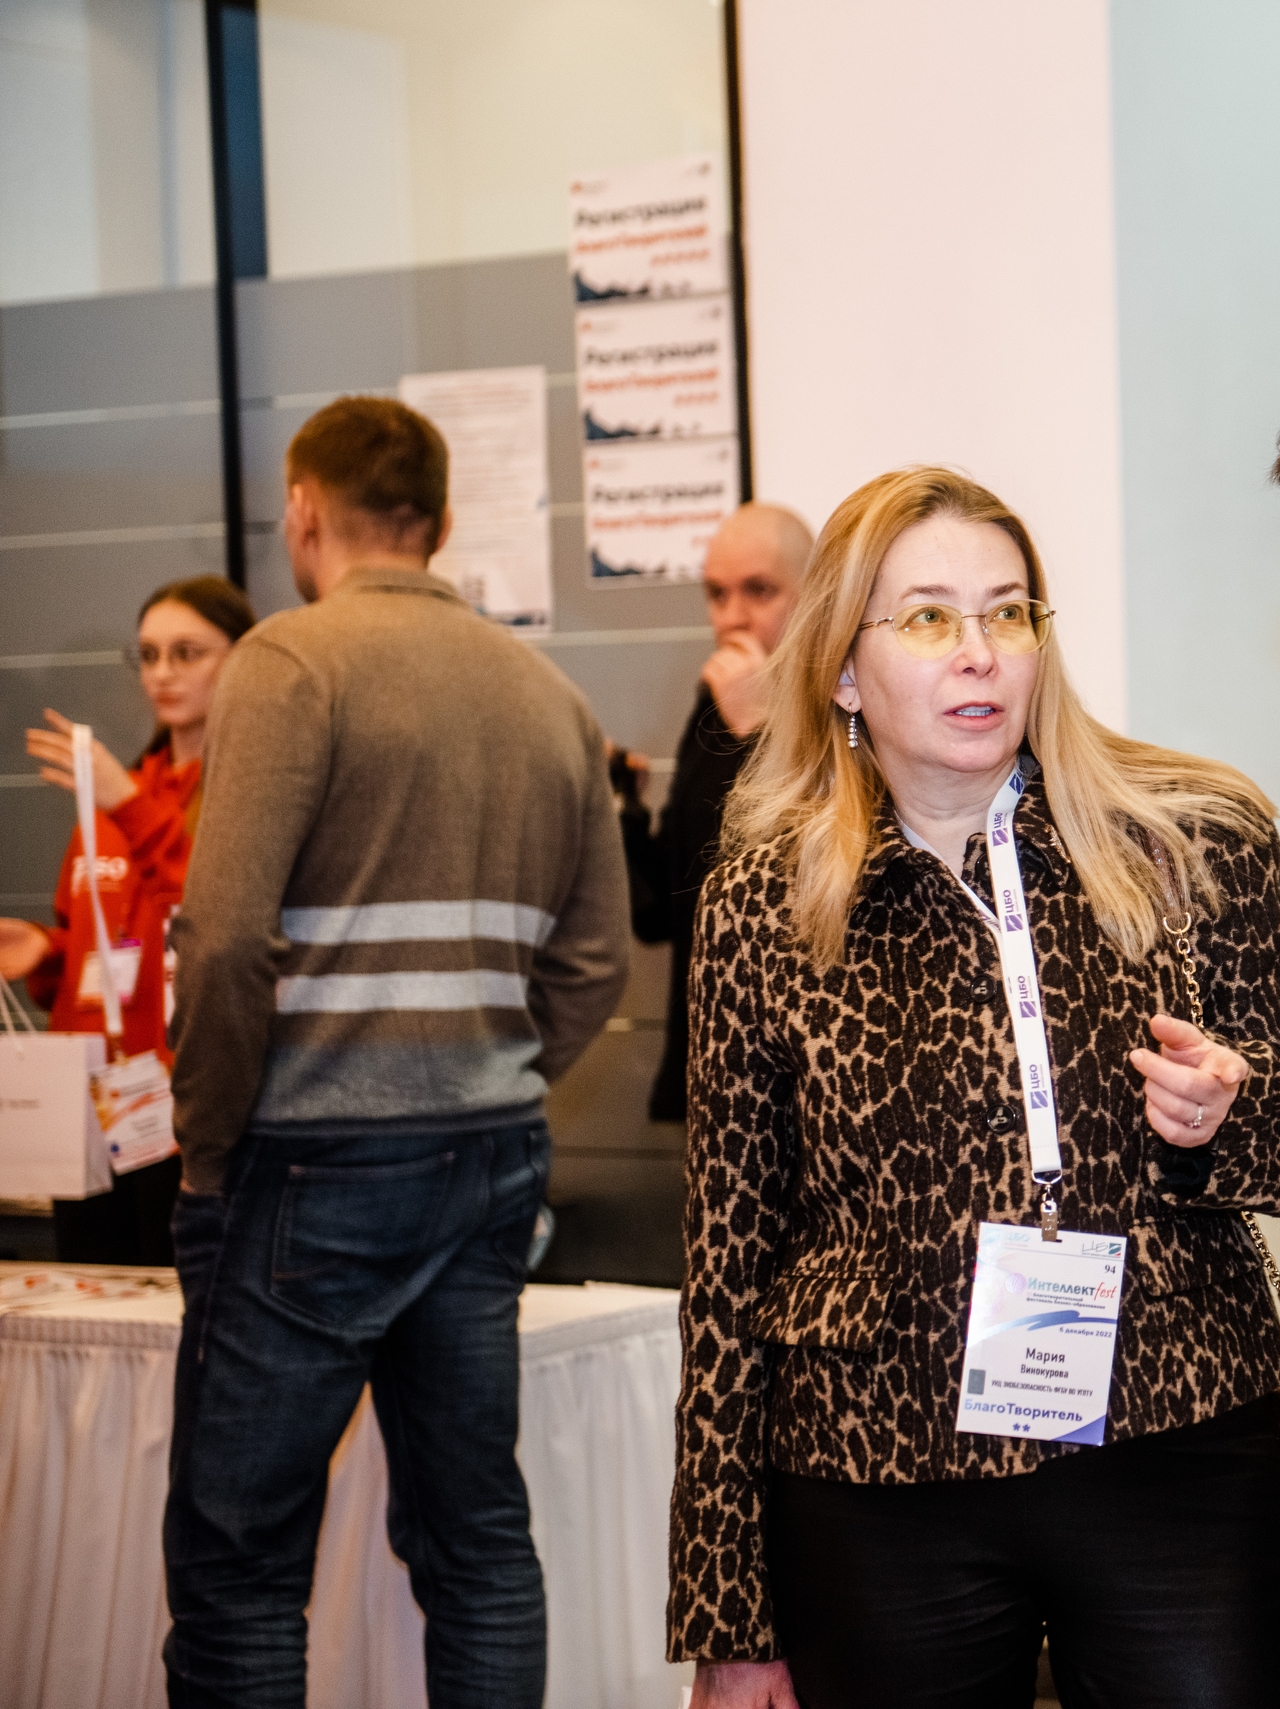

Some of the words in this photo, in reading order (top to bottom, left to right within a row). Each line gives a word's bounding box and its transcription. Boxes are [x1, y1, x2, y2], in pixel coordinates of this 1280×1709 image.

[1002, 889, 1014, 913] ЦБО
[1018, 975, 1028, 999] ЦБО
[1030, 1064, 1040, 1089] ЦБО
[1104, 1264, 1117, 1275] 94
[1065, 1328, 1094, 1337] декабря
[1095, 1331, 1113, 1339] 2022
[1026, 1348, 1066, 1364] Мария
[1020, 1364, 1069, 1379] Винокурова
[964, 1399, 1083, 1422] БлагоТворитель
